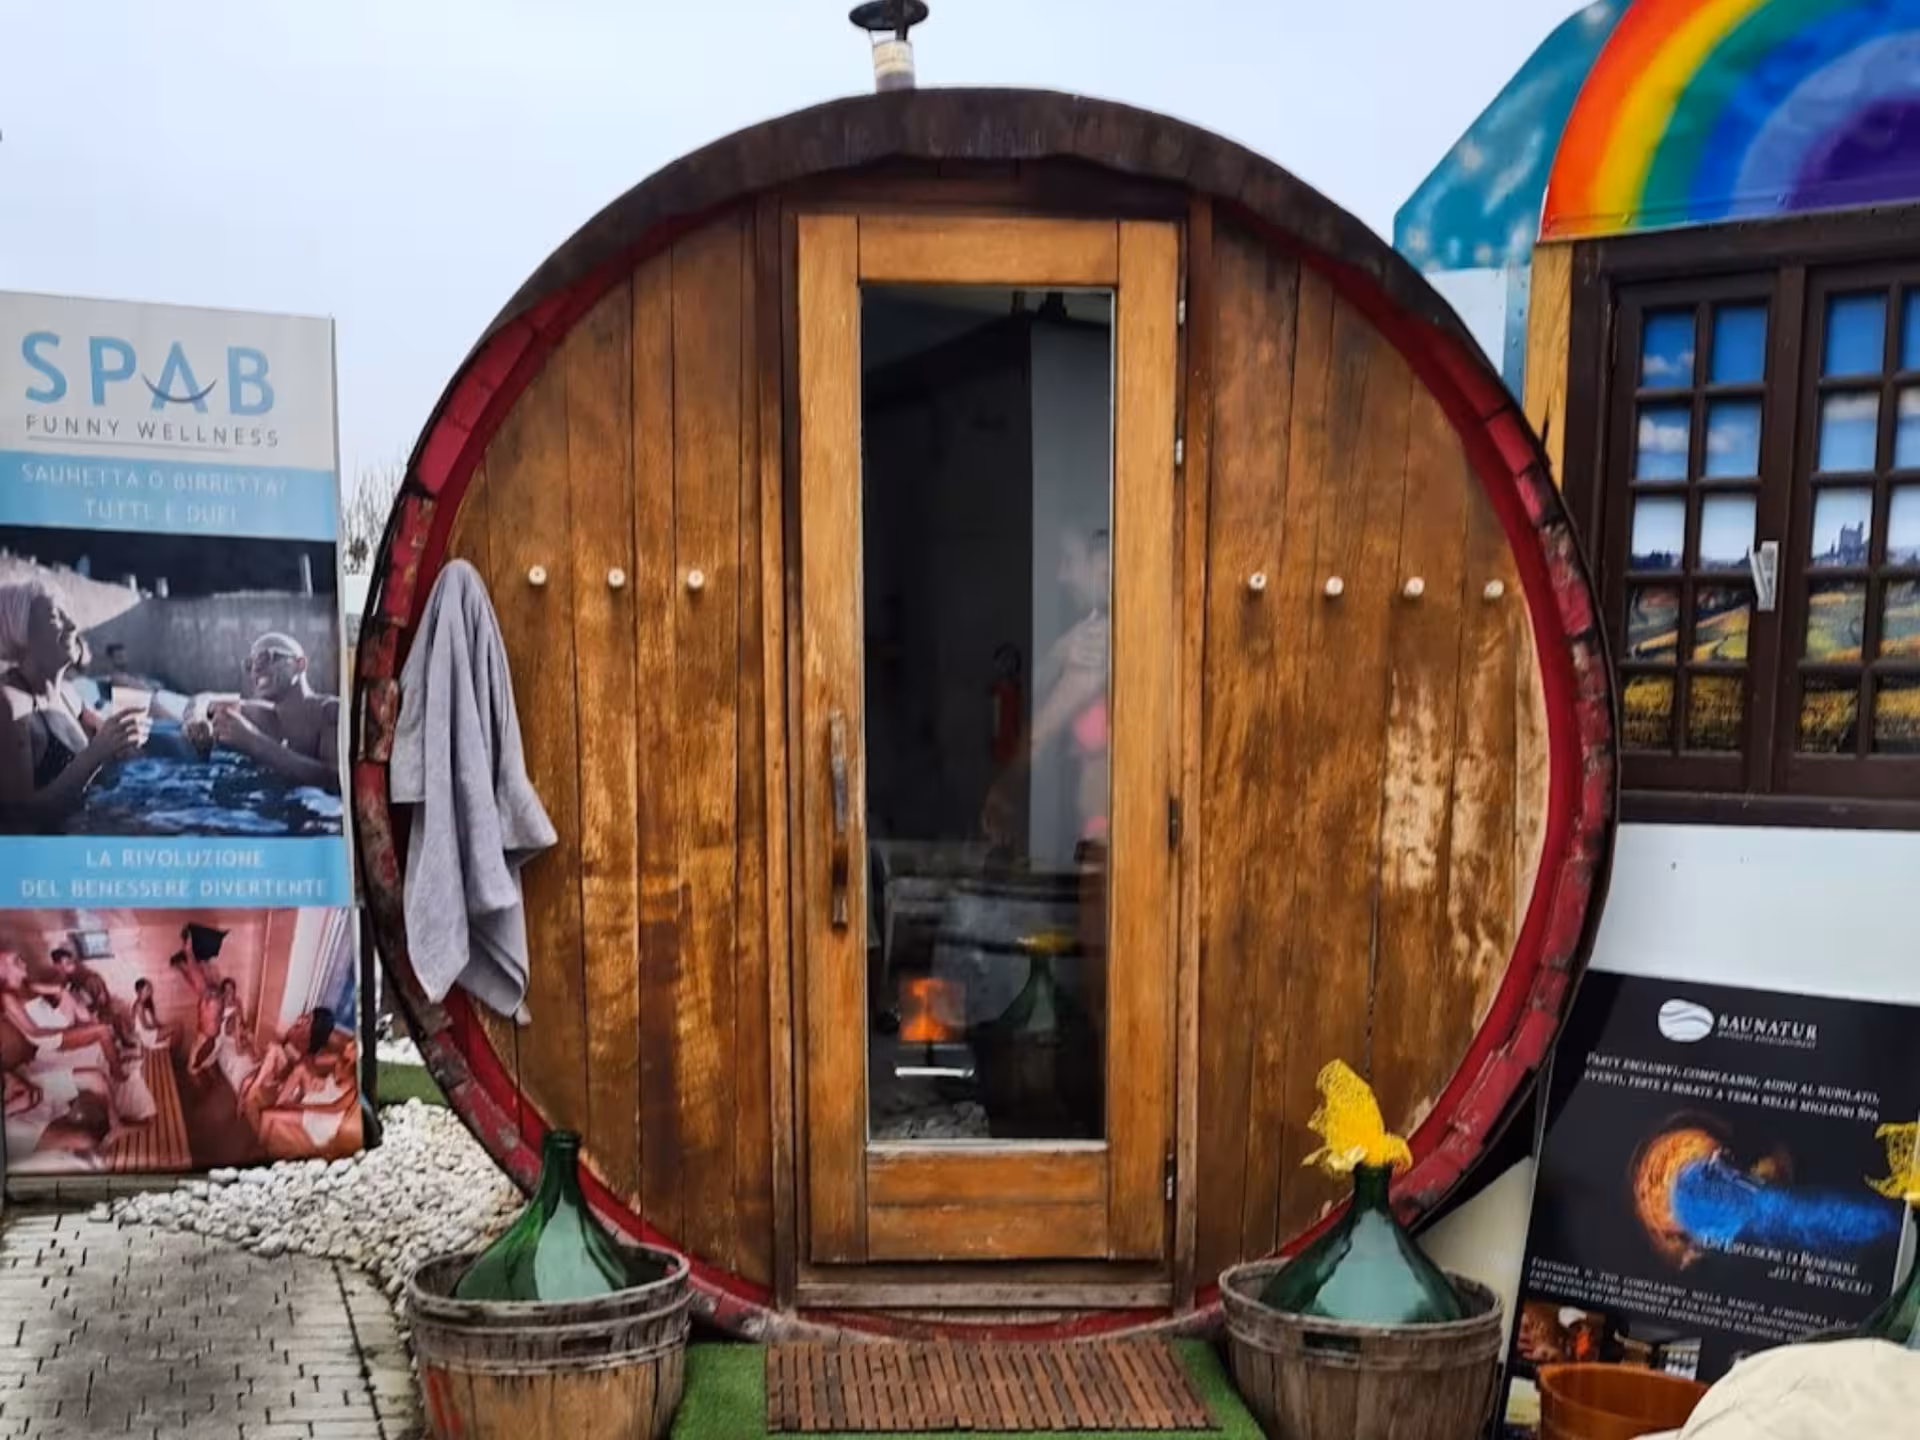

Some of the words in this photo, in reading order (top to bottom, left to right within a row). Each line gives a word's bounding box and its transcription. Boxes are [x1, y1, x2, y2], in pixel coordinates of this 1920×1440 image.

[21, 329, 276, 416] SPAB
[25, 414, 120, 437] FUNNY
[137, 421, 280, 447] WELLNESS
[21, 462, 138, 489] SAUNETTA
[86, 849, 112, 868] LA
[122, 849, 266, 868] RIVOLUZIONE
[21, 879, 60, 898] DEL
[71, 879, 190, 898] BENESSERE
